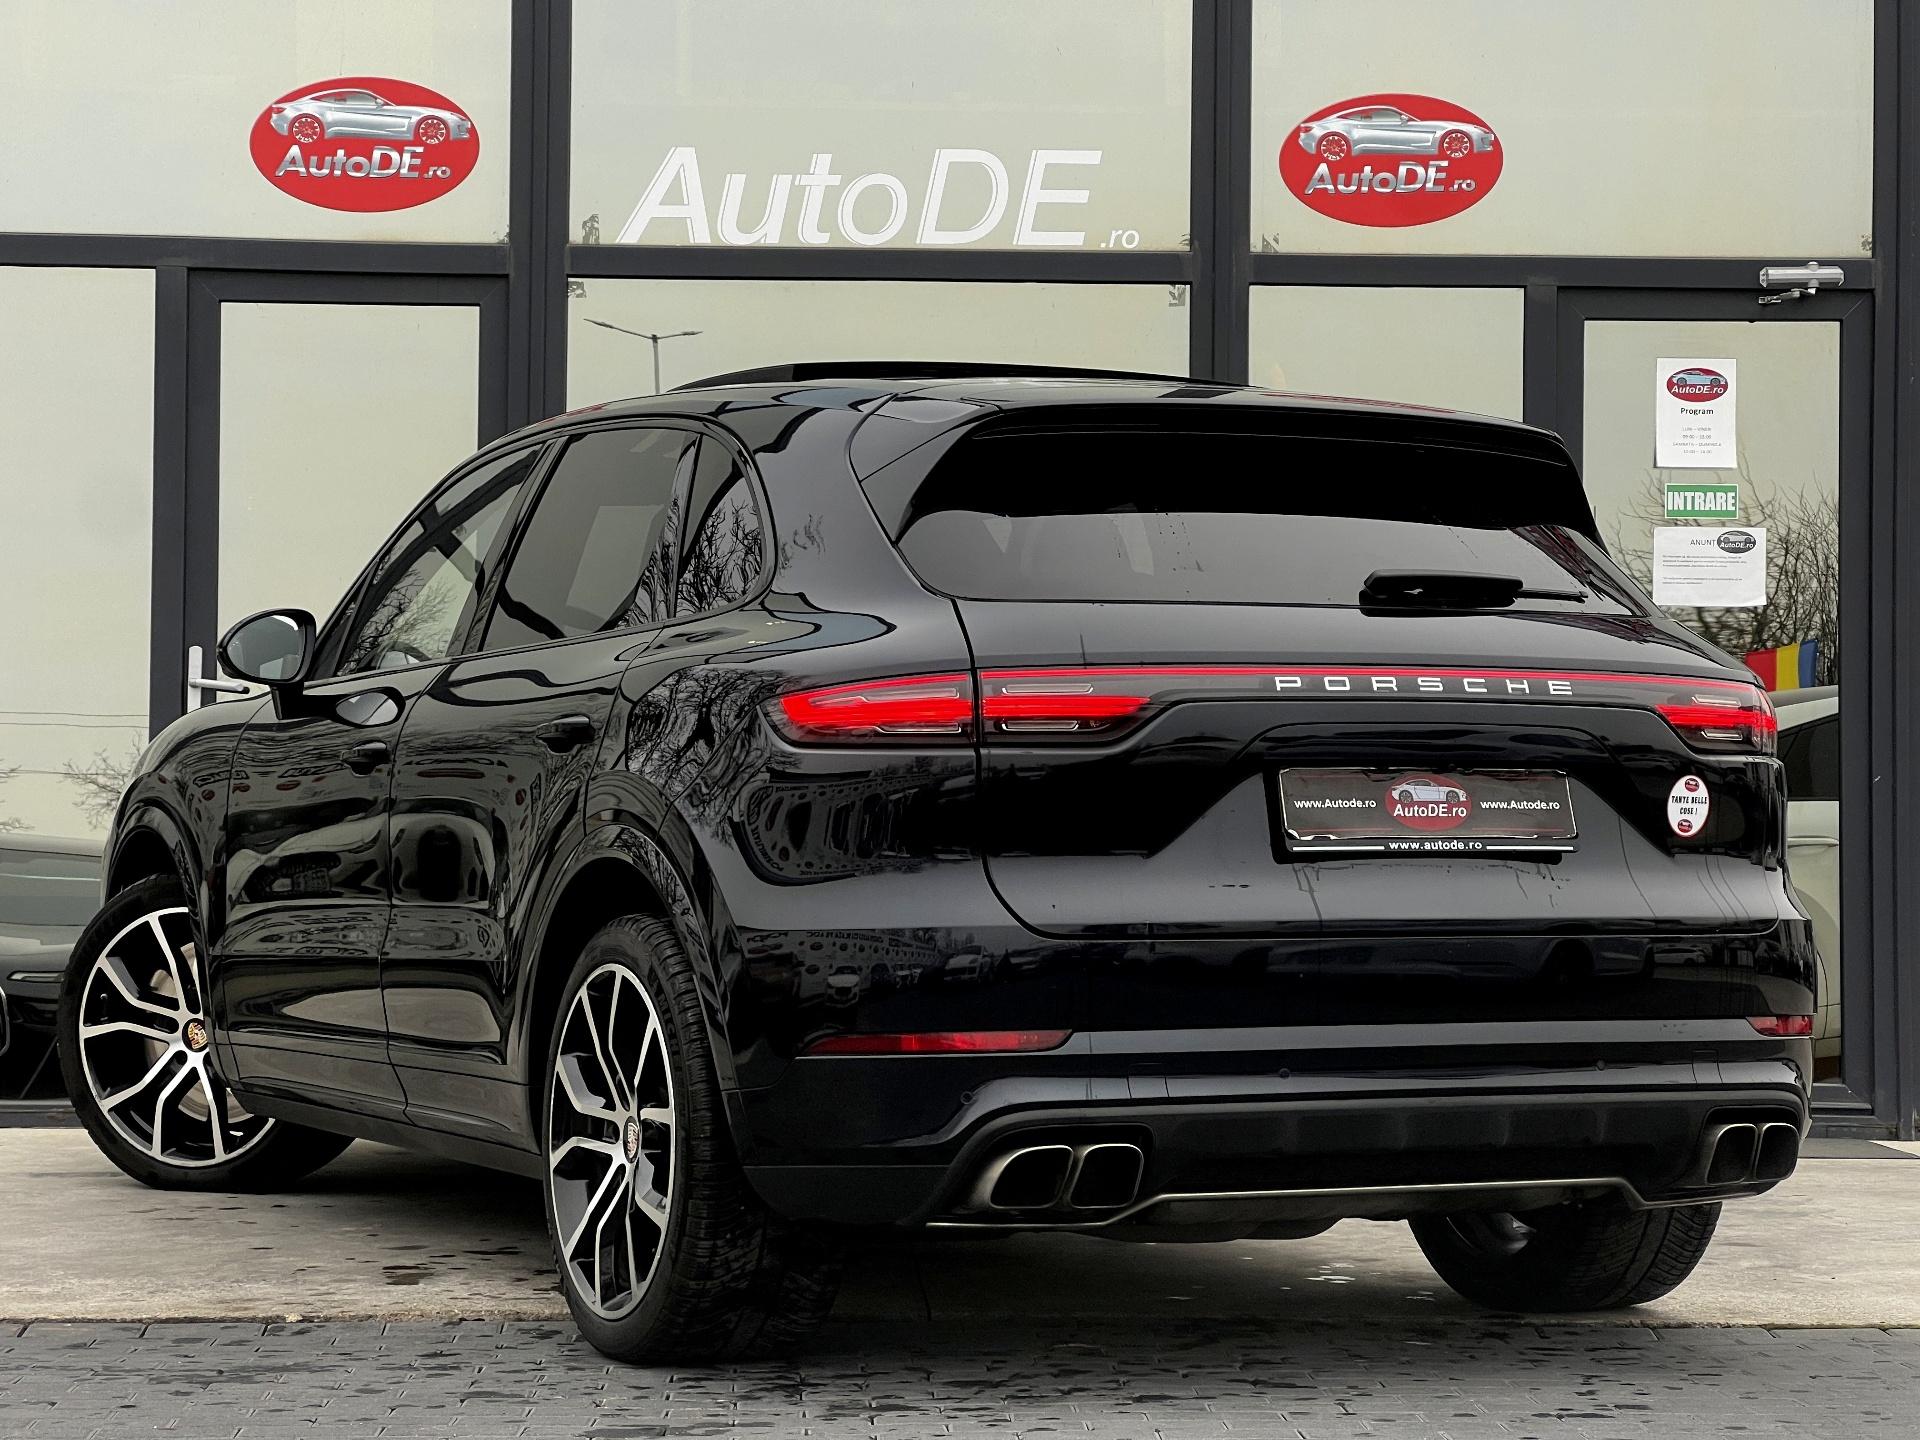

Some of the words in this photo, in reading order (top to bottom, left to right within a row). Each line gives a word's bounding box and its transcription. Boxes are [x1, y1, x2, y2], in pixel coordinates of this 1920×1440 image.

[275, 144, 451, 179] AutoDE.ro
[1304, 160, 1477, 194] AutoDE.ro
[615, 146, 1141, 250] AutoDE.ro
[1671, 385, 1724, 394] AutoDE.ro
[1680, 407, 1714, 416] Program
[1667, 491, 1736, 511] INTRARE
[1274, 676, 1573, 696] PORSCHE
[1294, 798, 1377, 809] www.Autode.ro
[1480, 800, 1561, 811] www.Autode.ro
[1393, 803, 1467, 818] AutoDE.ro
[1679, 807, 1694, 815] COSE
[1389, 840, 1483, 851] www.autode.ro
